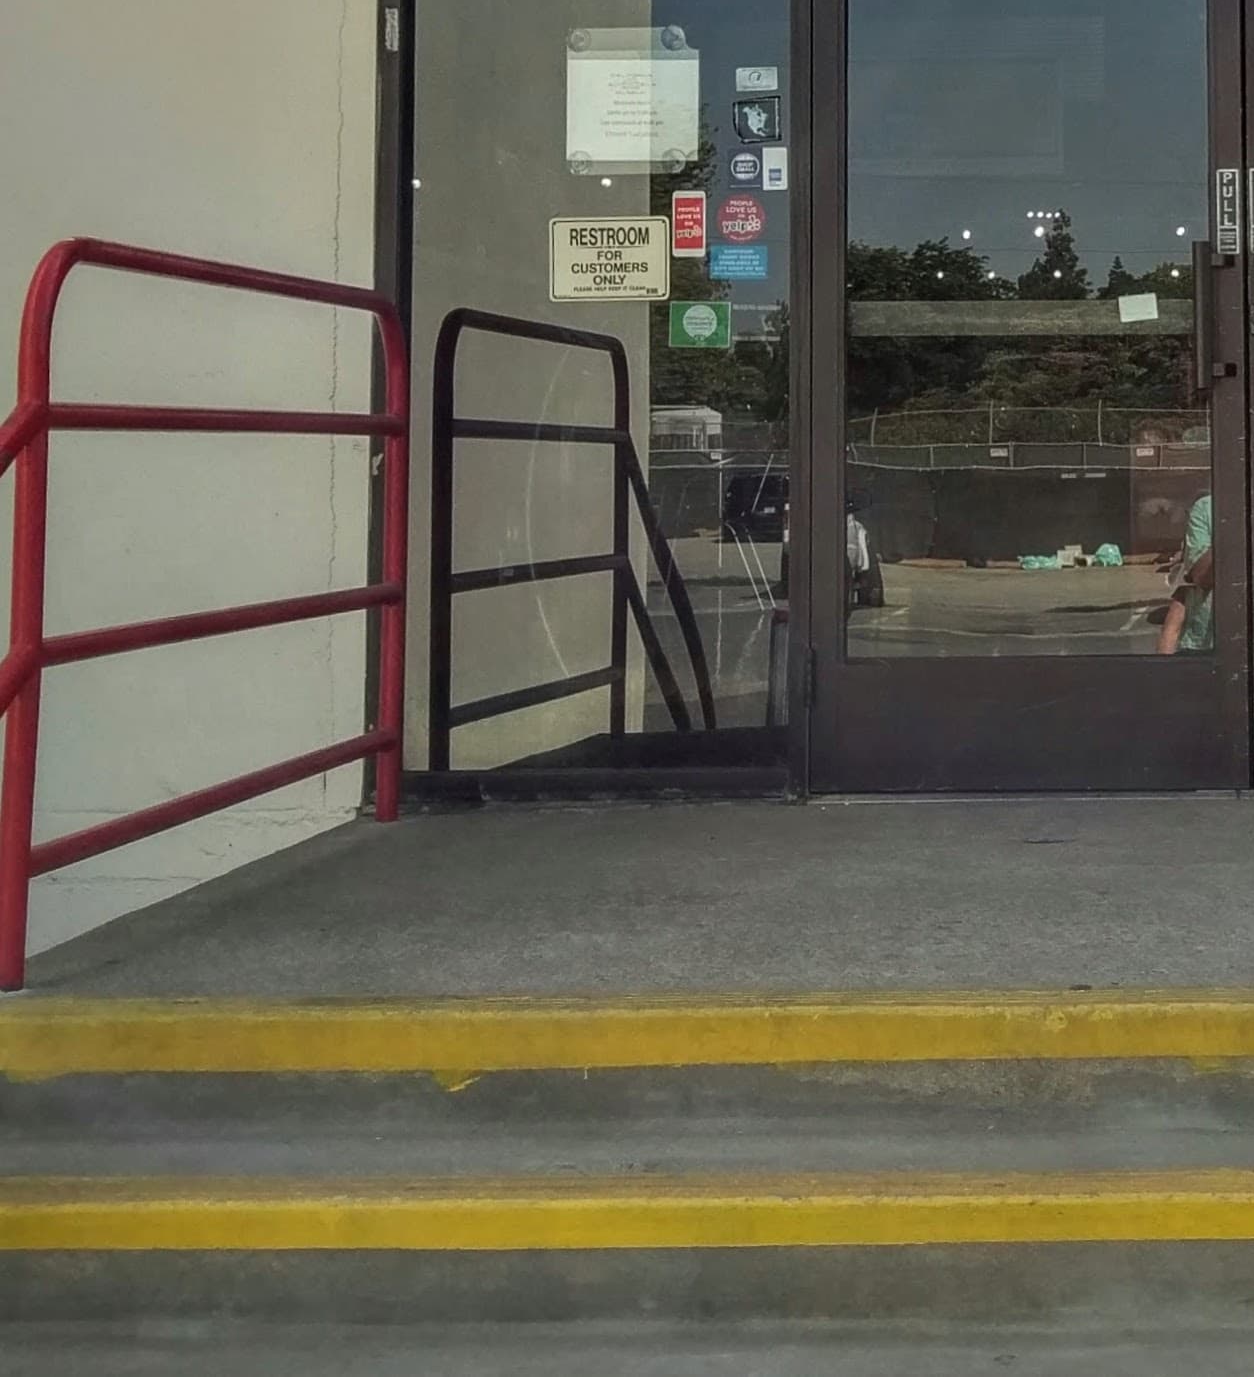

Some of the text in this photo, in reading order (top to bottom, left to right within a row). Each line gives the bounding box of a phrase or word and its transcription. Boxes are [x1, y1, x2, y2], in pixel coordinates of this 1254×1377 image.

[1222, 172, 1233, 225] PULL
[722, 220, 748, 234] yelp
[569, 227, 650, 246] RESTROOM
[596, 250, 623, 261] FOR
[571, 262, 649, 274] CUSTOMERS
[592, 274, 627, 286] ONLY
